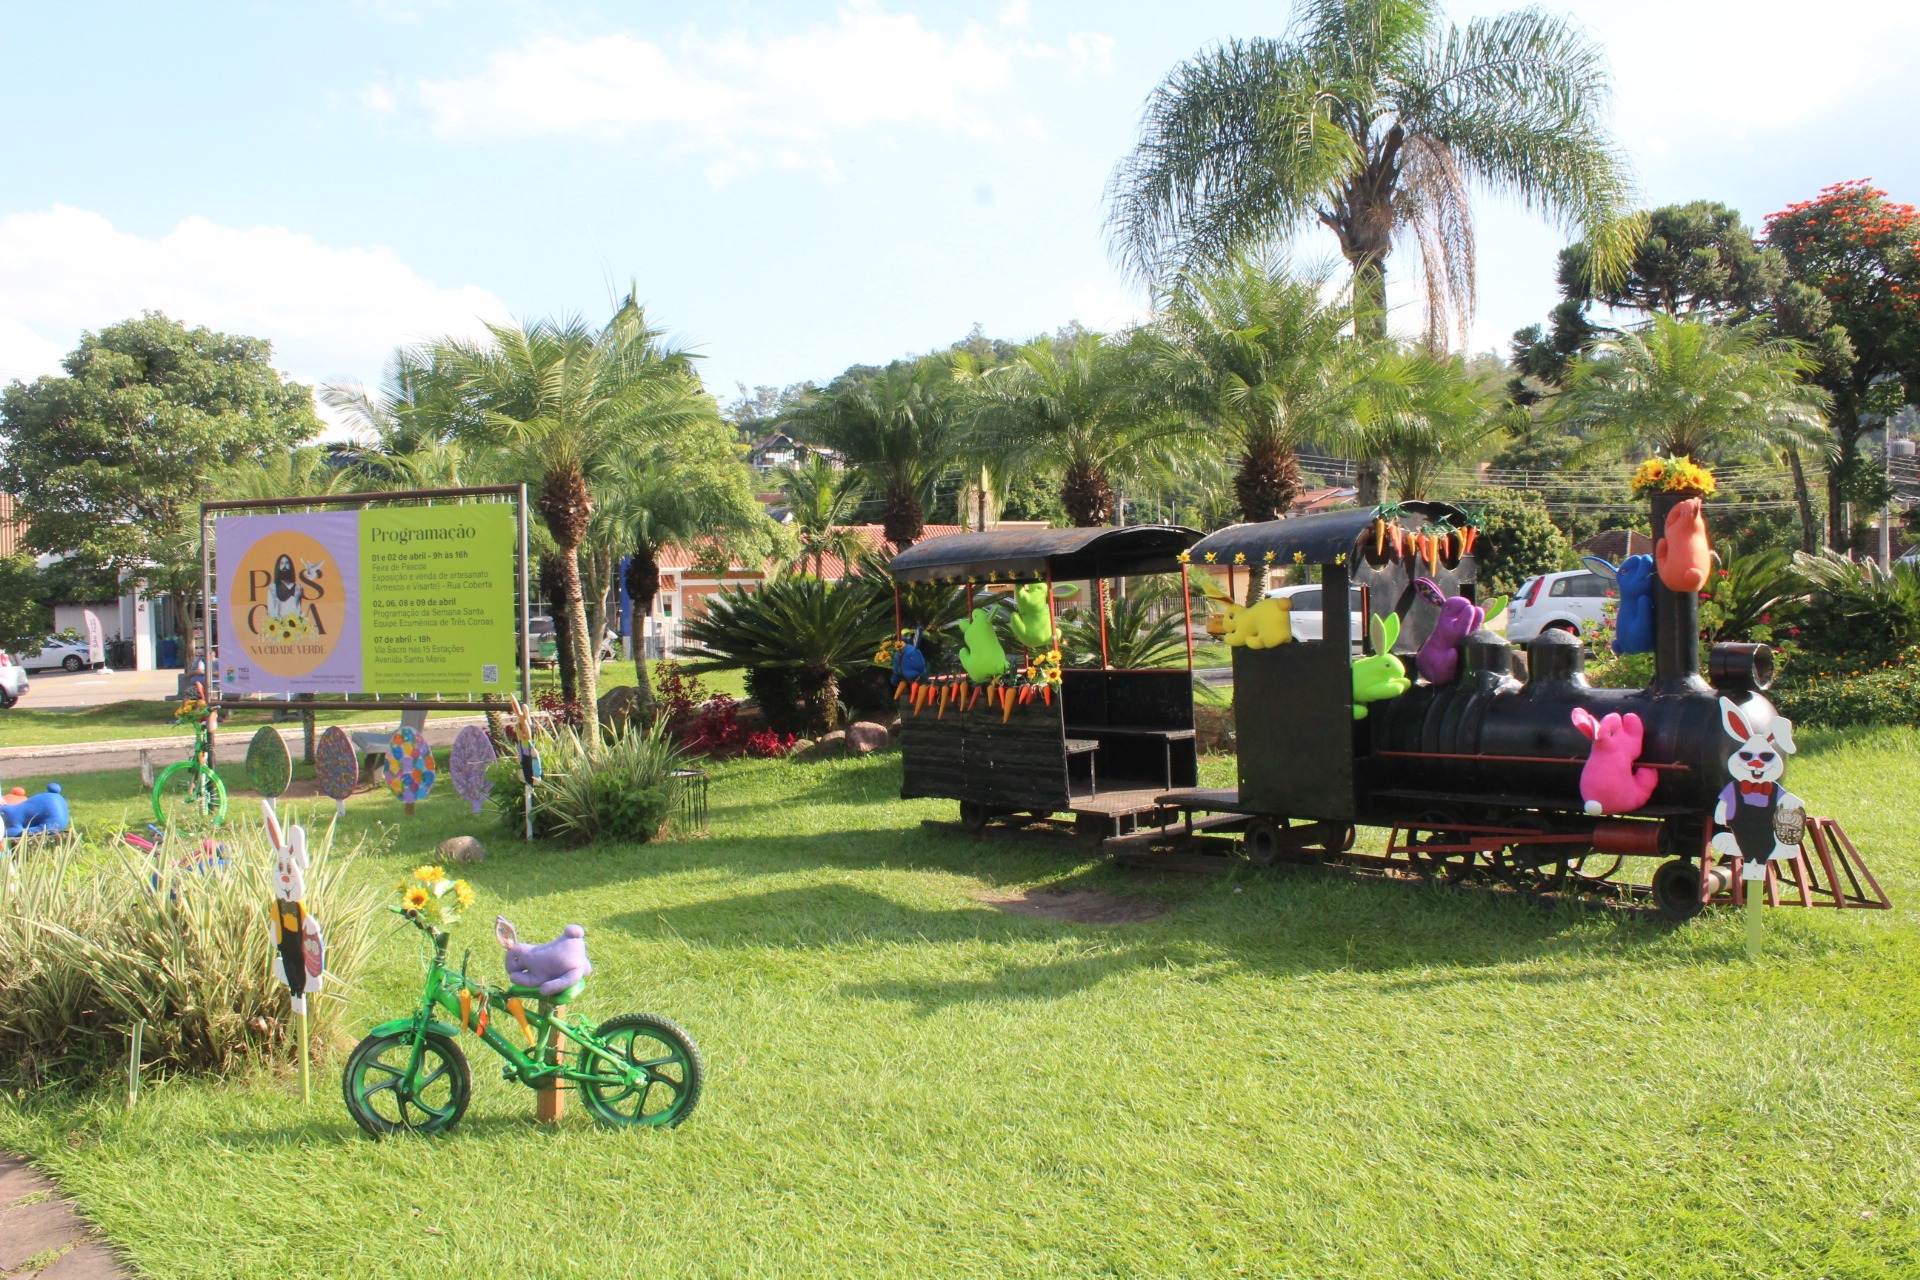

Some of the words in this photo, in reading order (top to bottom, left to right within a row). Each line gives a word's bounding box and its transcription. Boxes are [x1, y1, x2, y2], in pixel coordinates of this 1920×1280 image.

[372, 524, 476, 544] Programação
[410, 552, 426, 560] abril
[373, 573, 407, 582] Exposição
[373, 610, 419, 619] Programação
[374, 620, 397, 628] Equipe
[468, 617, 493, 625] Coroas
[264, 645, 295, 654] CIDADE
[297, 645, 326, 654] VERDE
